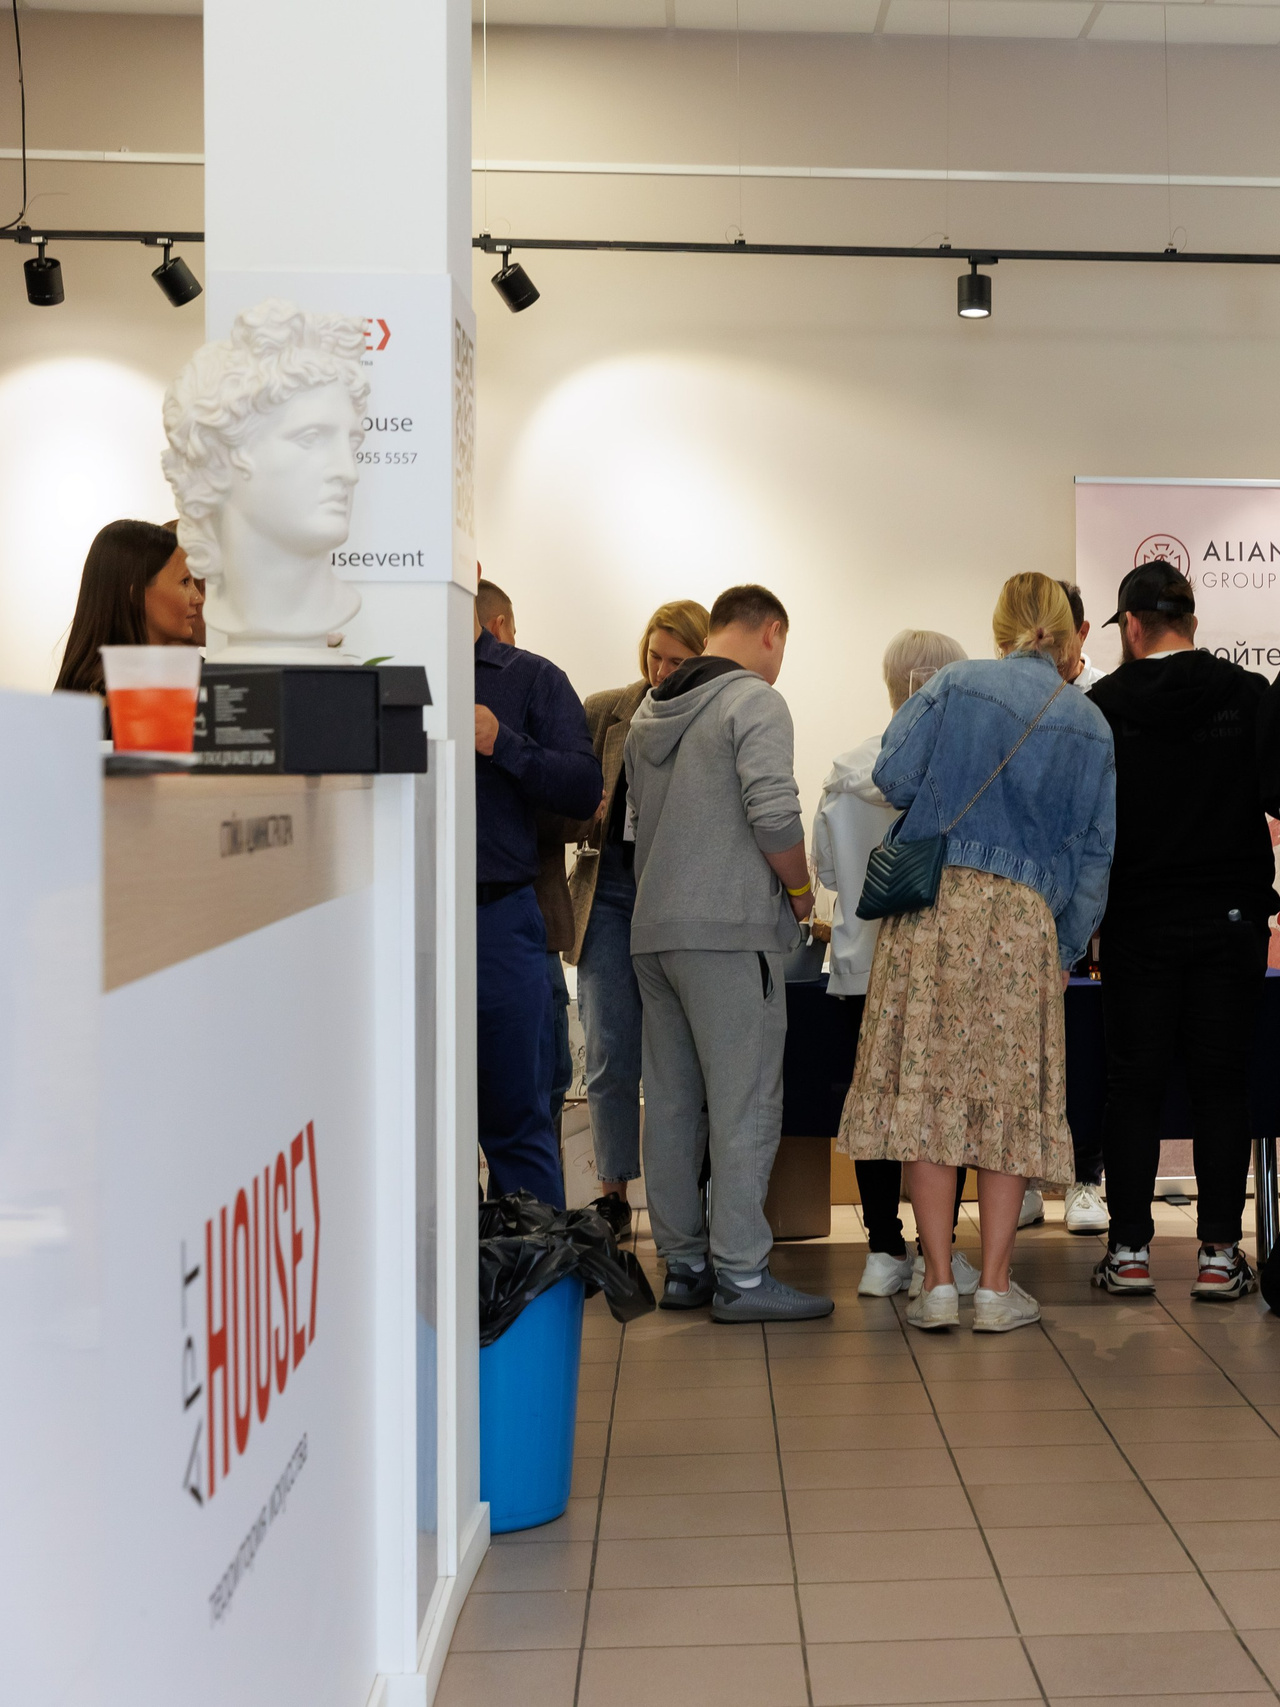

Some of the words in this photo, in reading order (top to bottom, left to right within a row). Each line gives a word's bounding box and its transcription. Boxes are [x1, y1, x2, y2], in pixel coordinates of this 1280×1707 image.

[360, 416, 413, 432] ouse
[356, 451, 381, 464] 955
[385, 452, 418, 464] 5557
[1202, 571, 1277, 589] GROUP
[206, 1130, 306, 1500] HOUSE
